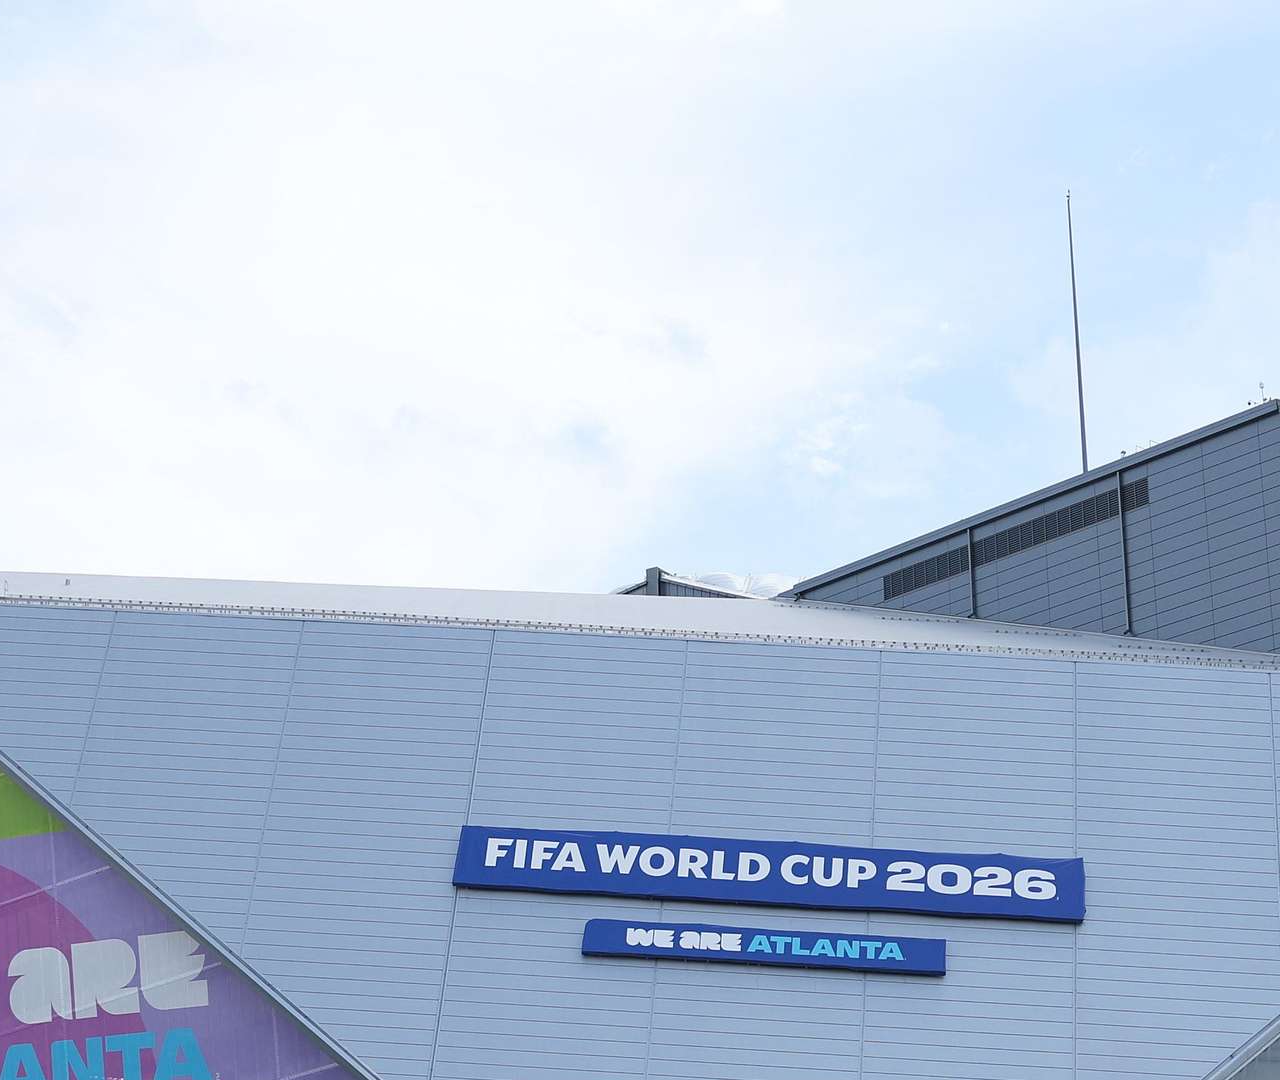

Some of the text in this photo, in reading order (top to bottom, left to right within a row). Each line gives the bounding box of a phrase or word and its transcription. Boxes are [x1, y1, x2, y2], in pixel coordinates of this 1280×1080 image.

[484, 837, 1057, 900] FIFA WORLD CUP 2026
[626, 928, 904, 961] WE ARE ATLANTA
[8, 930, 208, 1024] ARE
